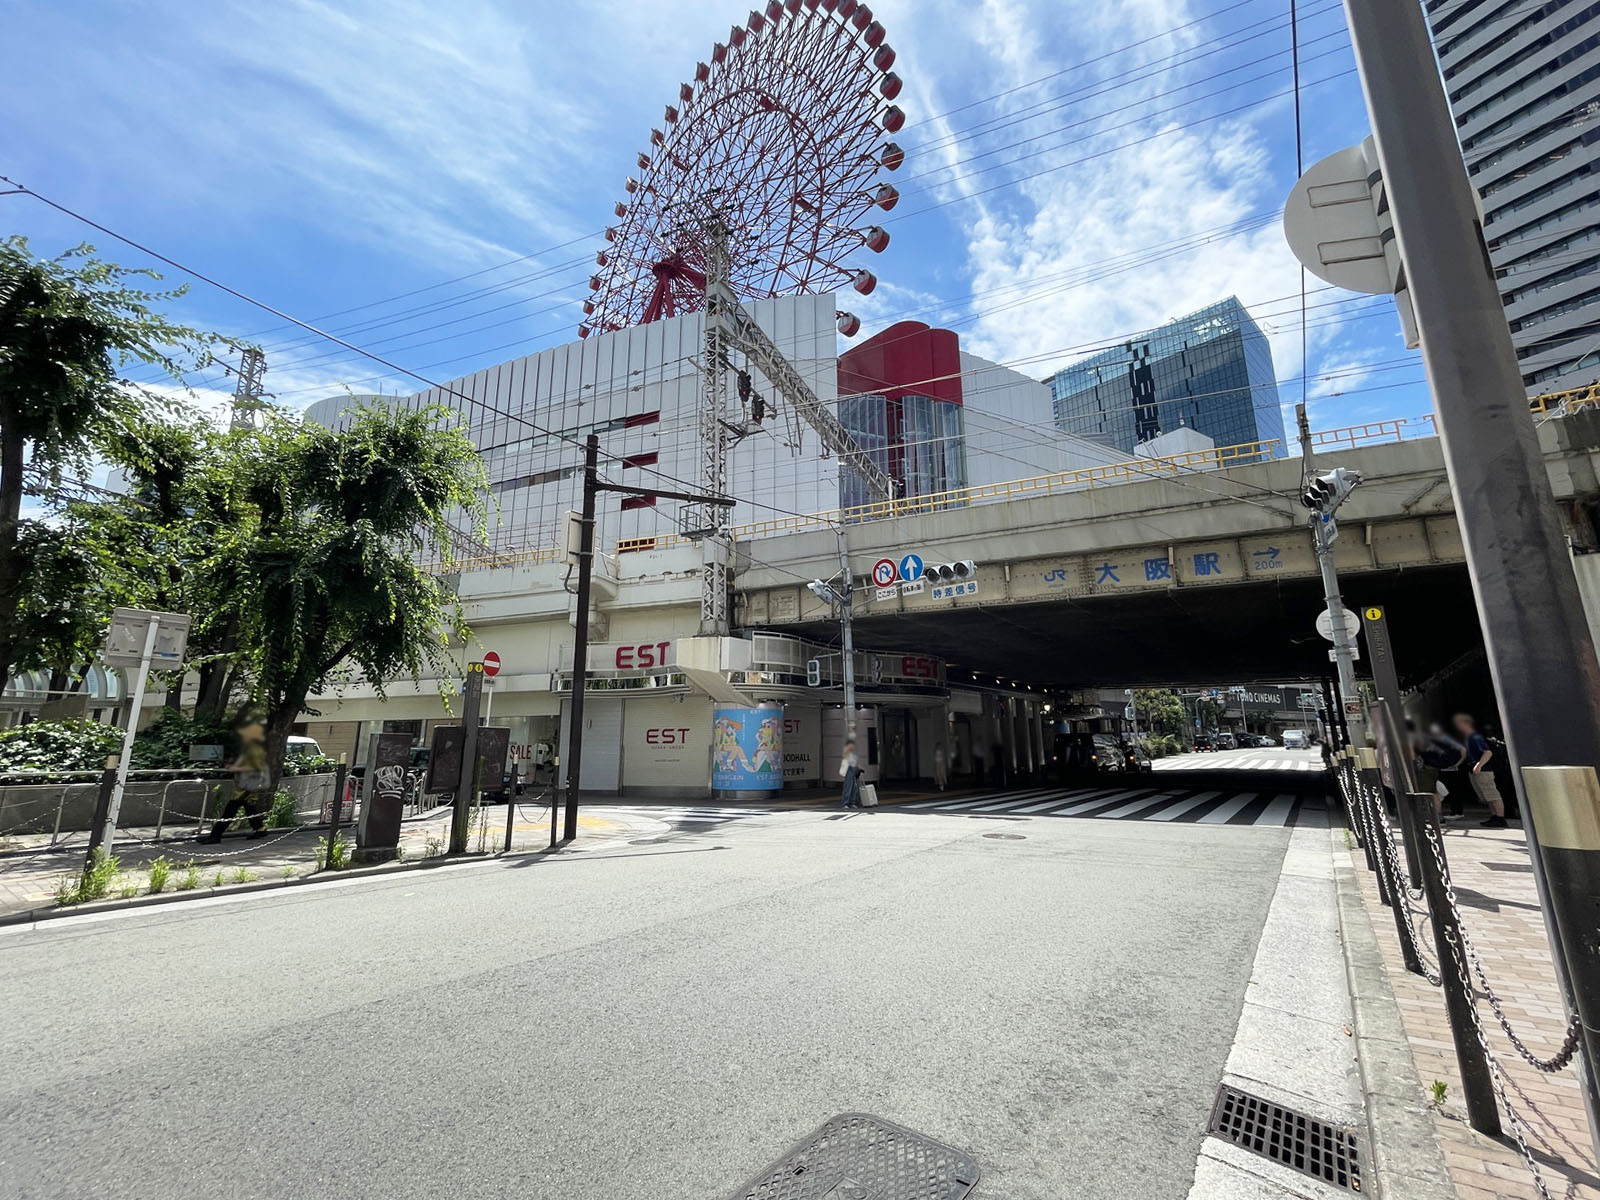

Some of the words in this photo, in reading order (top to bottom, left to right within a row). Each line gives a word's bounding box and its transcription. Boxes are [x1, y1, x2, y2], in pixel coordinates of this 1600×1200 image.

[1044, 569, 1066, 582] JR
[1095, 552, 1222, 584] 大阪駅
[1255, 561, 1283, 570] 200m
[877, 589, 896, 599] ここから
[933, 582, 977, 598] 時差信号
[615, 641, 671, 669] EST
[901, 656, 939, 678] EST
[1254, 692, 1281, 704] CINEMAS
[784, 719, 801, 734] ST
[646, 728, 690, 744] EST
[510, 745, 533, 760] SALE
